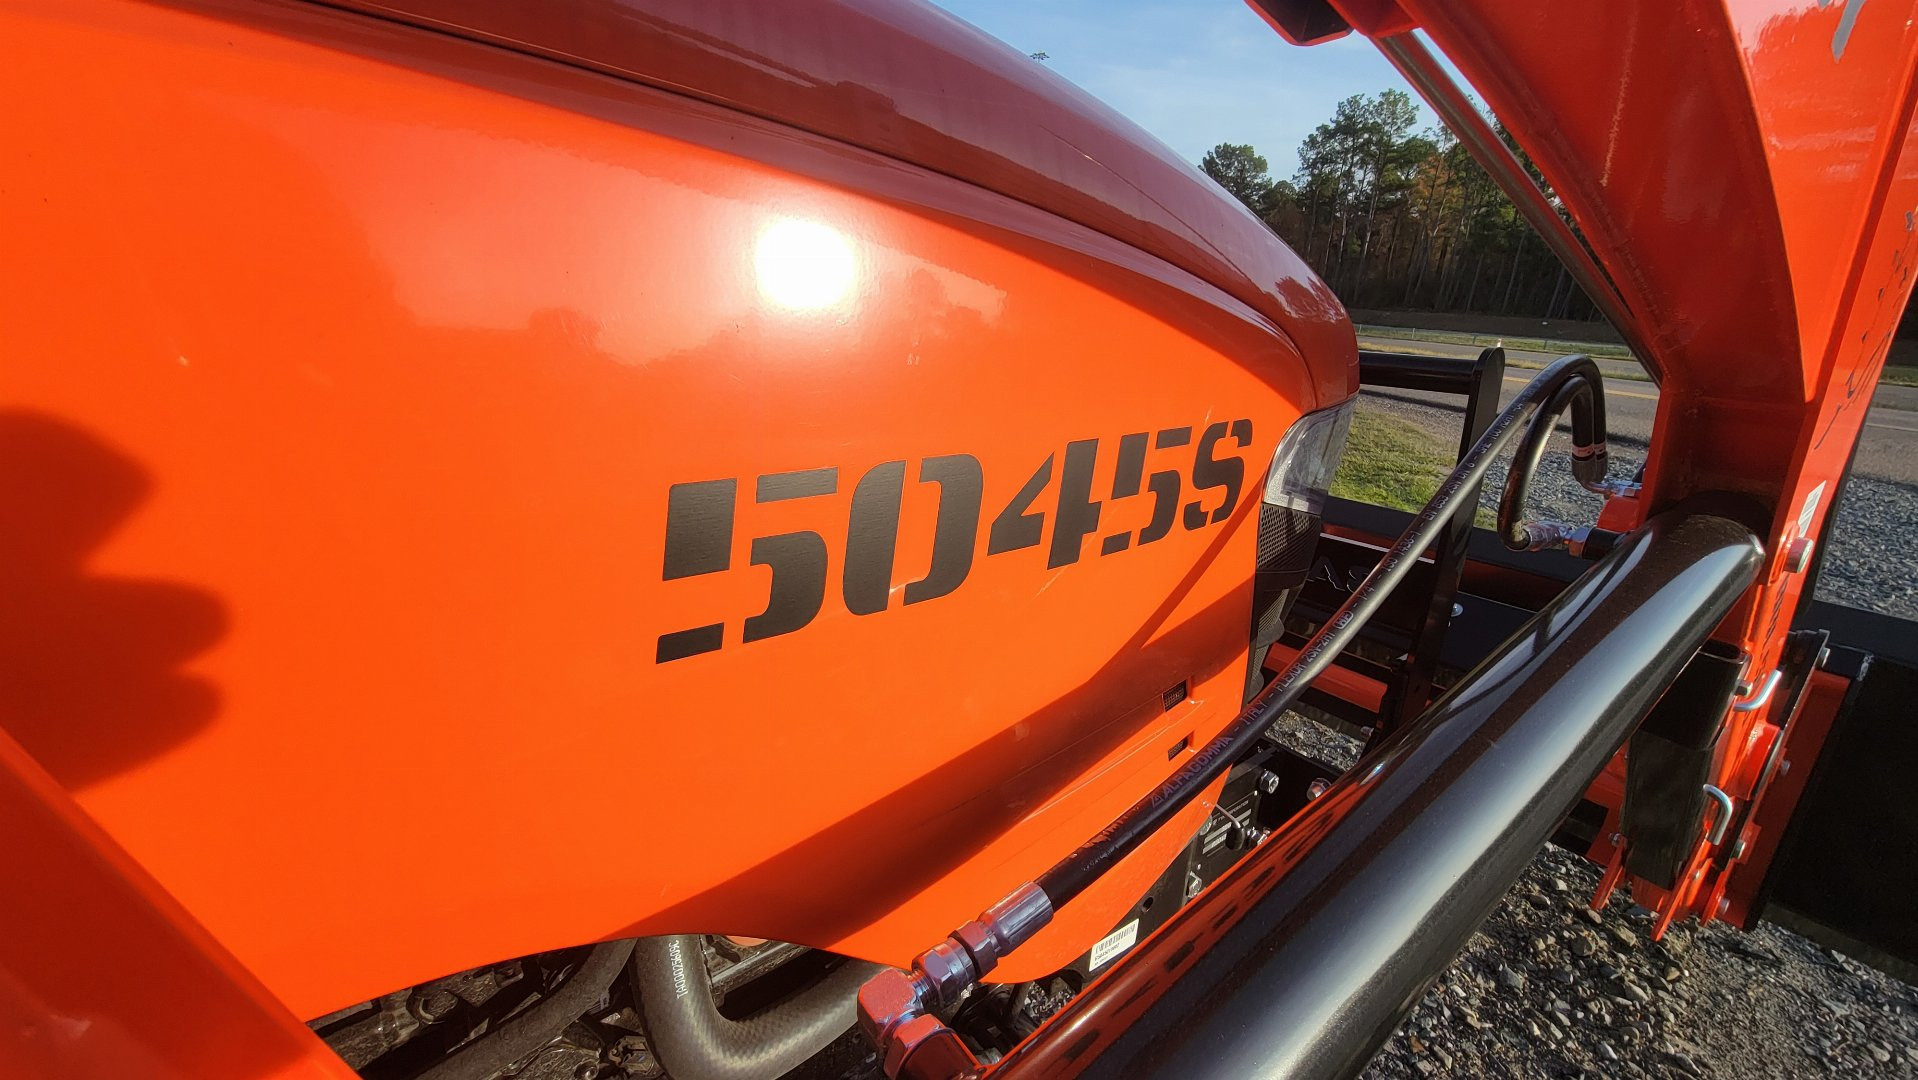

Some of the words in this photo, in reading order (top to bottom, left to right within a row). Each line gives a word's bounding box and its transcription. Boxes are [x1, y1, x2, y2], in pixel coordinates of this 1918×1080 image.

[655, 418, 1254, 664] 5045S
[1163, 736, 1234, 799] ALFAGOMMA
[1241, 700, 1269, 726] ITALY
